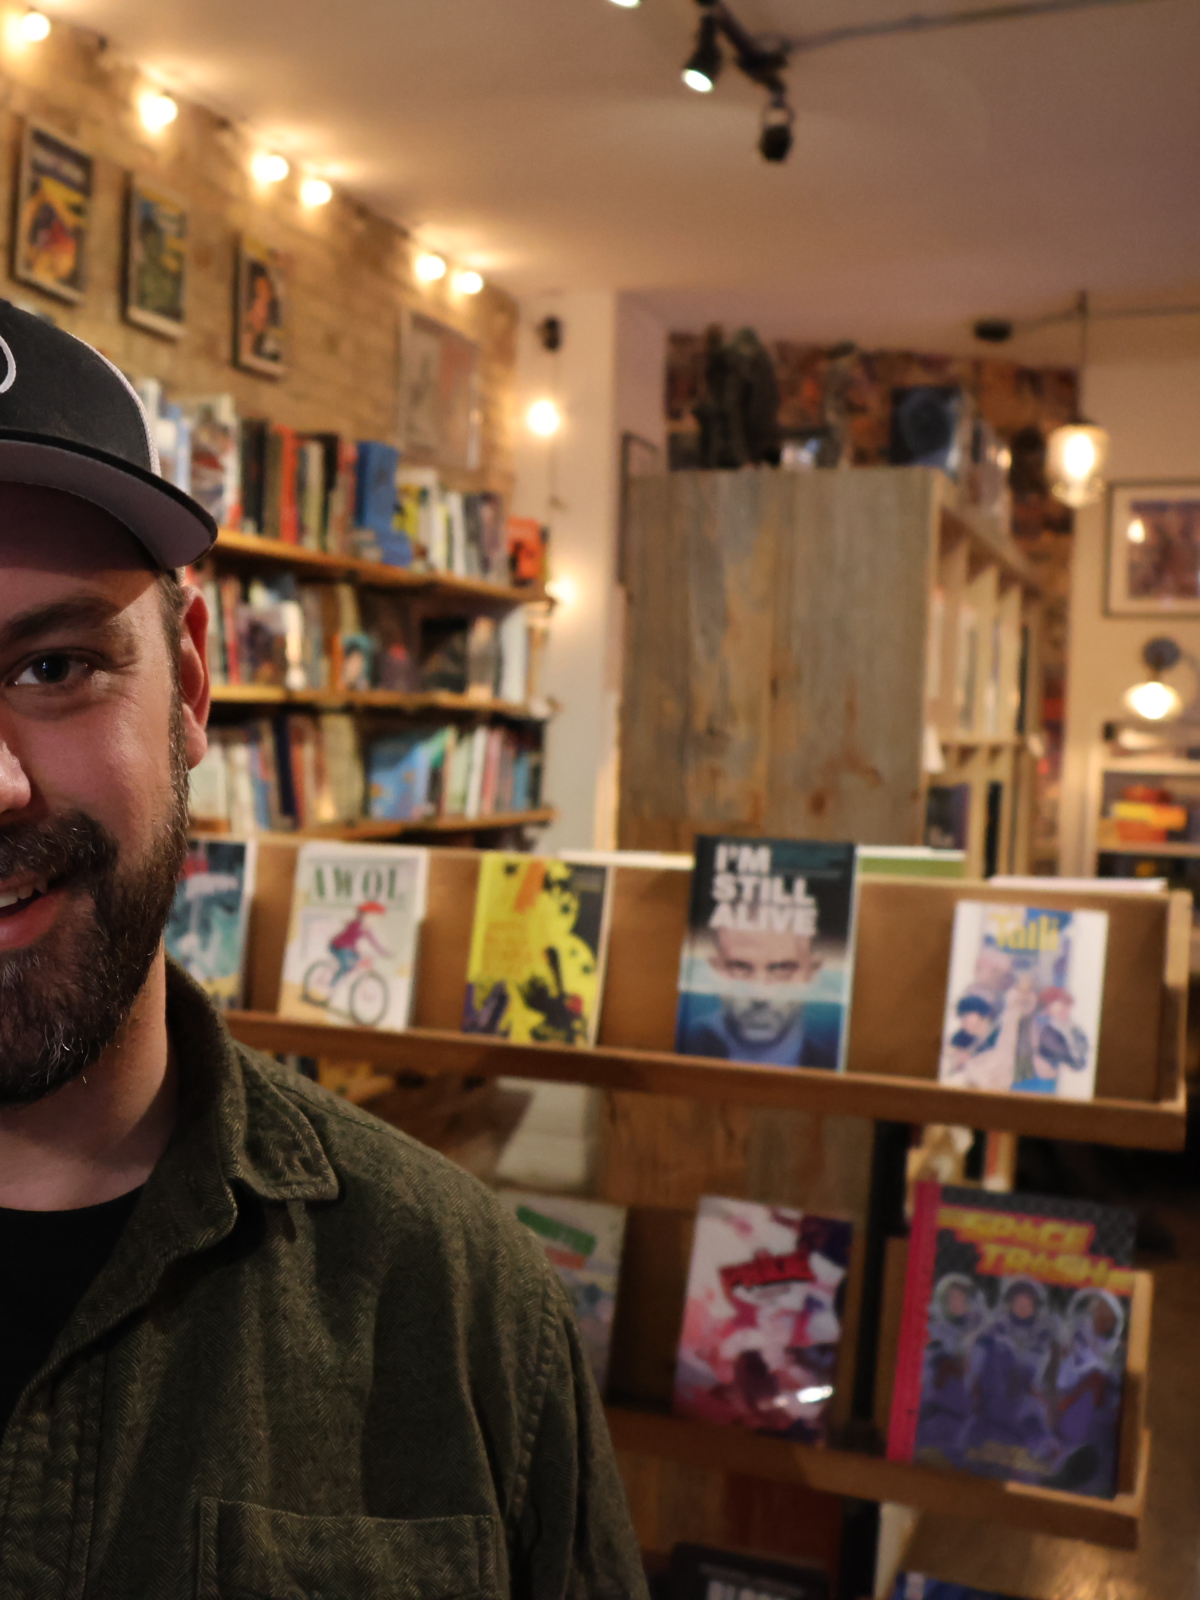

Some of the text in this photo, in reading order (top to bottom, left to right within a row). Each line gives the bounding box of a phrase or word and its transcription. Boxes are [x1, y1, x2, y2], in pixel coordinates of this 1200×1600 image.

[714, 843, 771, 873] I'M
[308, 864, 410, 901] AWOL
[712, 873, 817, 906] STILL
[708, 902, 817, 937] ALIVE
